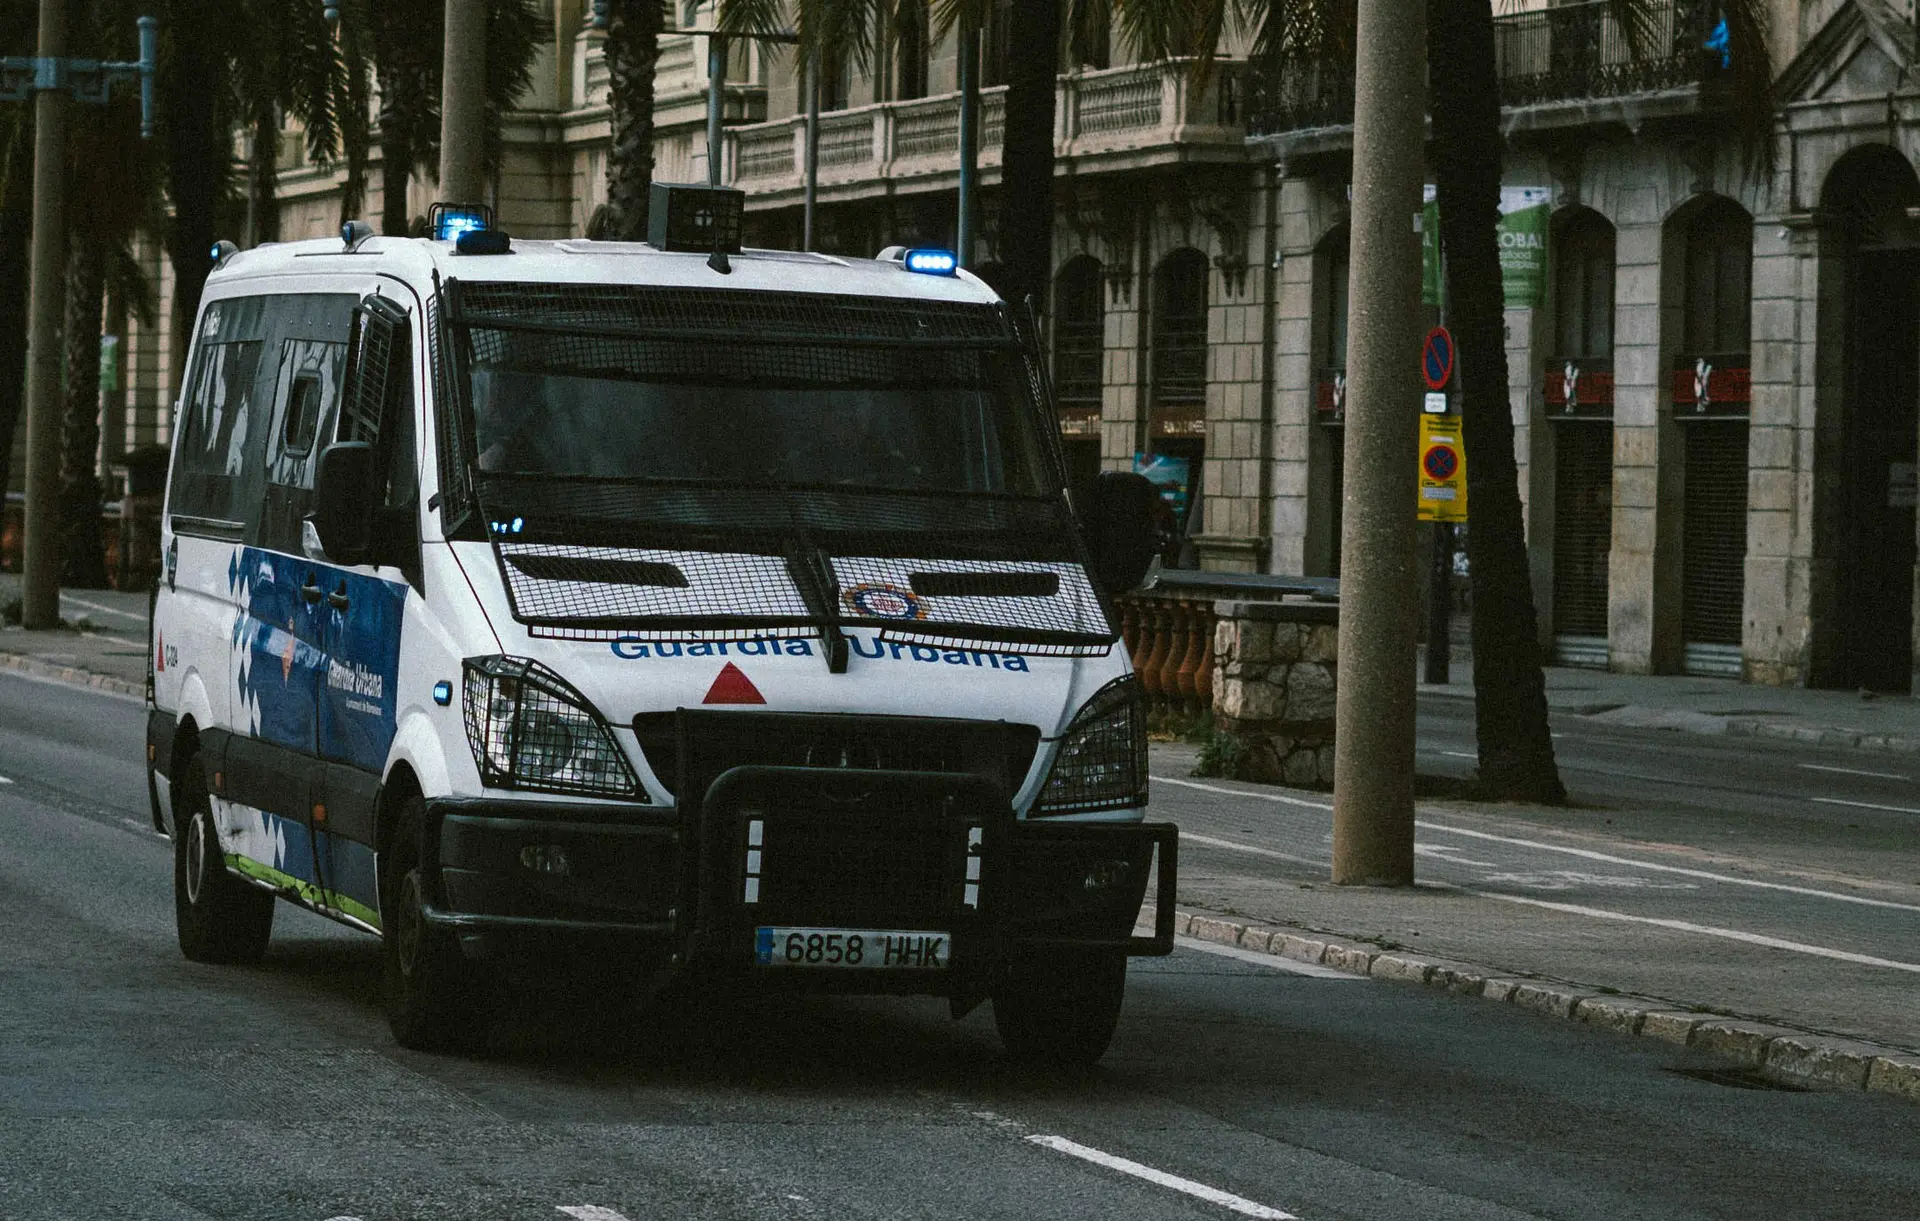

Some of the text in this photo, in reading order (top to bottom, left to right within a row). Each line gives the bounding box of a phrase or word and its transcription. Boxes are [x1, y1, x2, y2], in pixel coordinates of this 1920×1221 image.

[1498, 232, 1544, 249] OBAL
[850, 636, 1031, 673] Urbana
[785, 933, 943, 967] 6858 HHK
